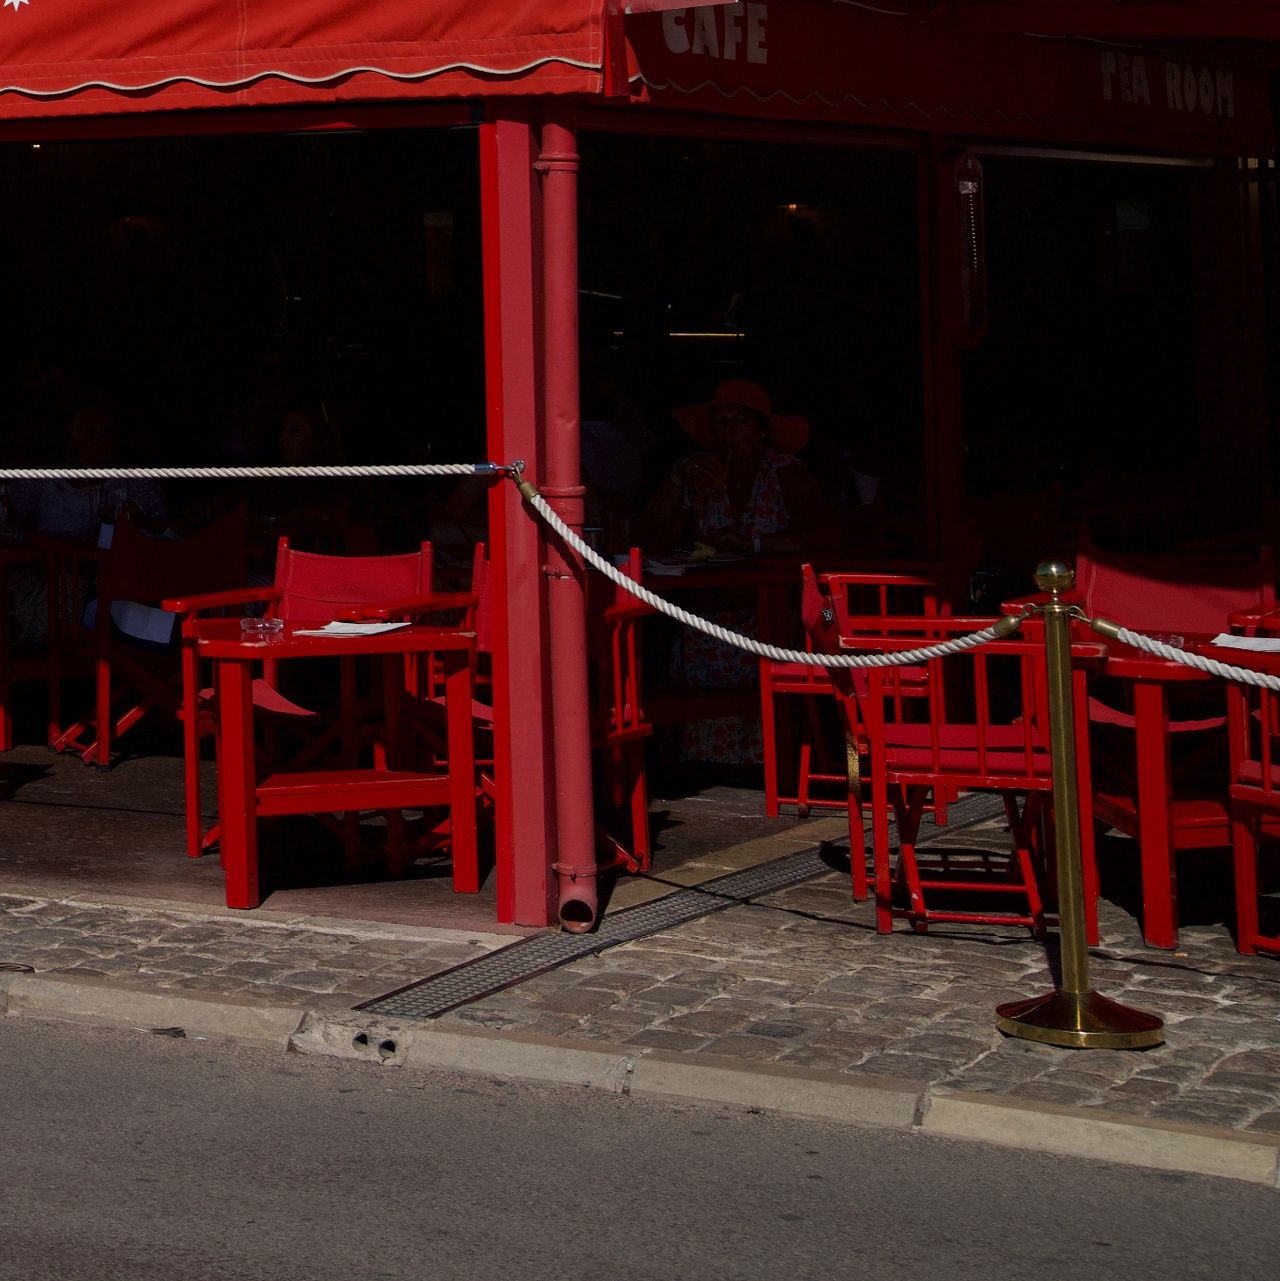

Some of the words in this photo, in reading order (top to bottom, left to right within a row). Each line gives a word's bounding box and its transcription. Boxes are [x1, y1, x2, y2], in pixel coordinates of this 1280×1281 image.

[661, 1, 768, 64] CAFE
[1101, 51, 1152, 107] TEA
[1165, 61, 1235, 118] ROOM
